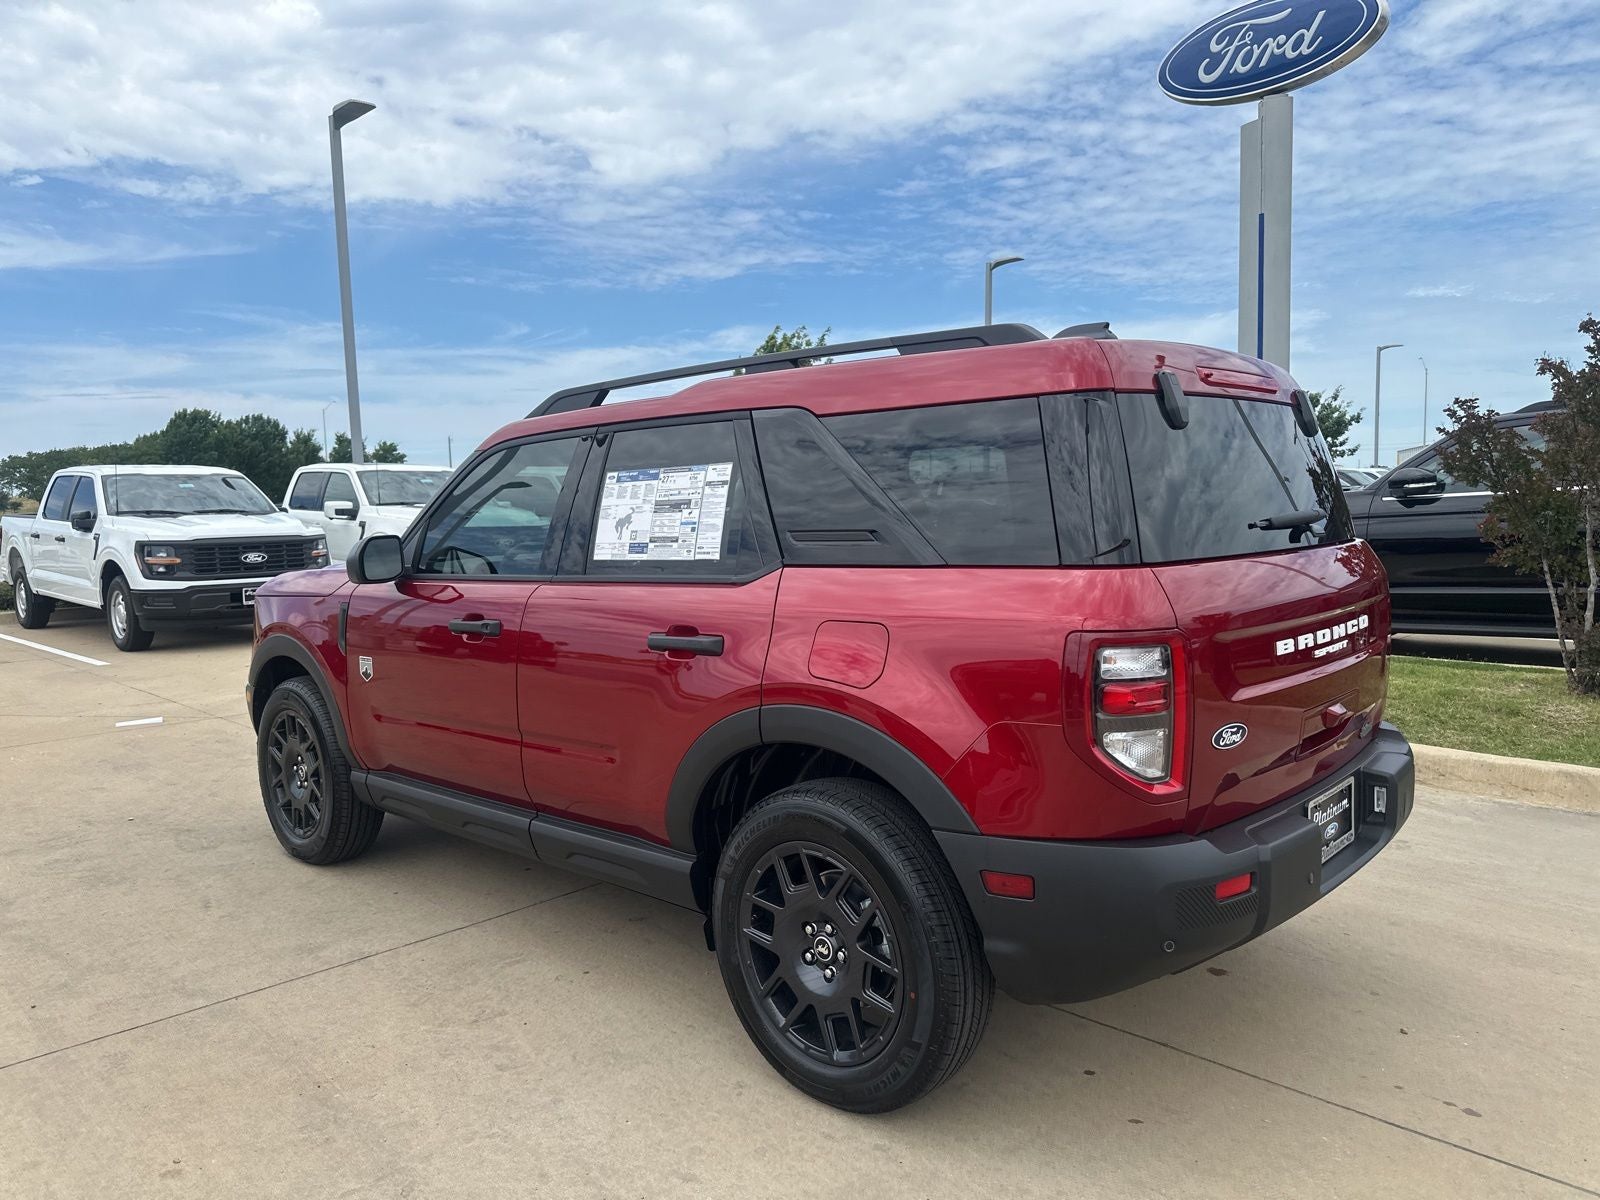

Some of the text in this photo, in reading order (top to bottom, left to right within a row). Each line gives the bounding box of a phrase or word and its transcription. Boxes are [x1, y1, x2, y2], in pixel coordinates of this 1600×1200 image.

[1198, 8, 1326, 84] Ford
[1276, 615, 1368, 656] BRONCO
[1314, 640, 1348, 658] SPORT
[1220, 727, 1242, 746] Ford
[1313, 798, 1350, 826] Platinum
